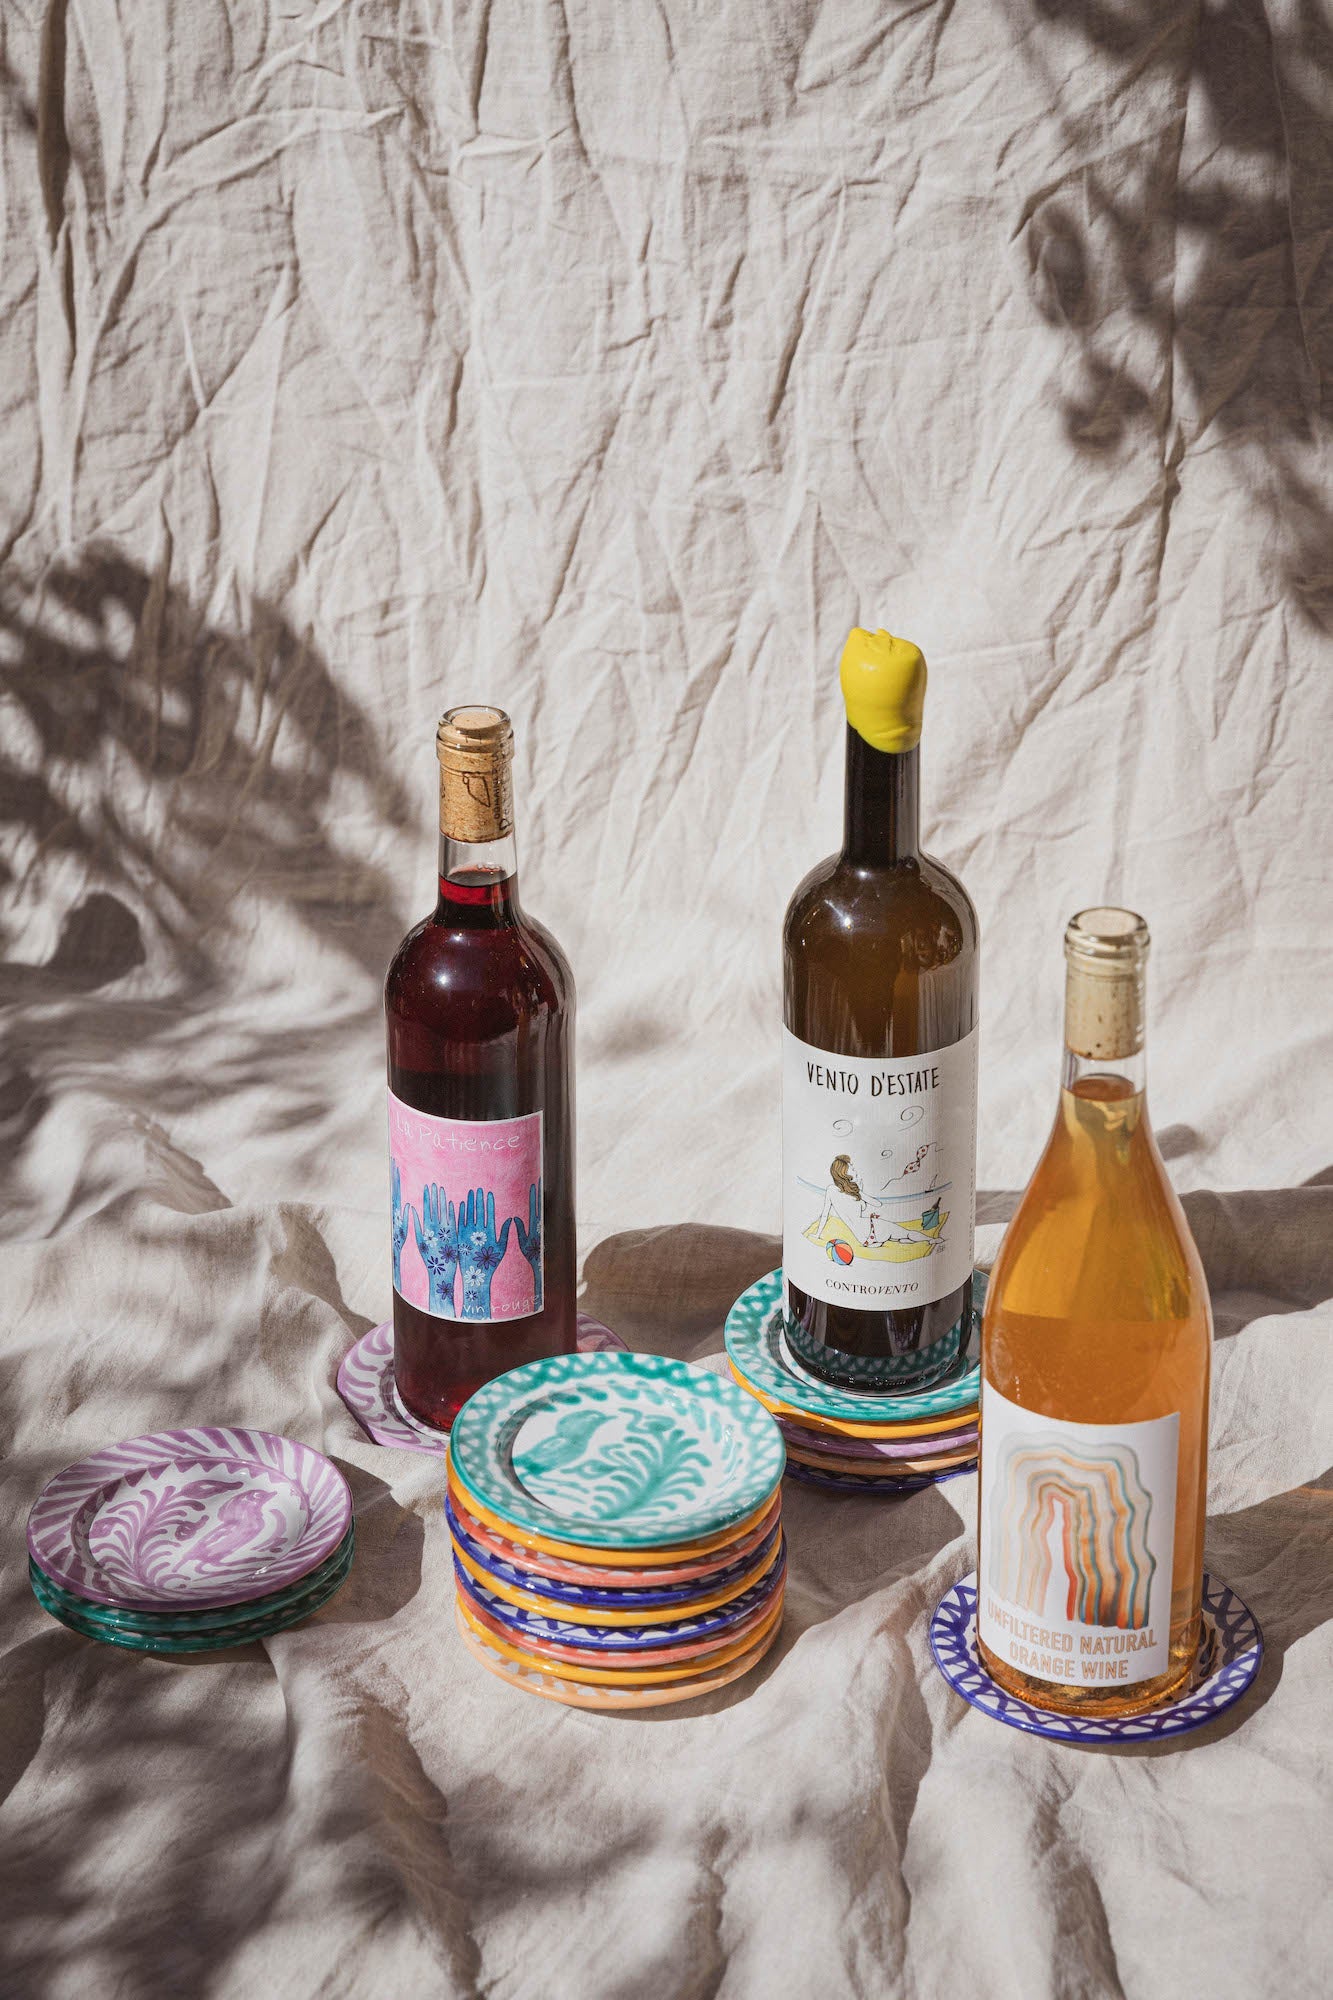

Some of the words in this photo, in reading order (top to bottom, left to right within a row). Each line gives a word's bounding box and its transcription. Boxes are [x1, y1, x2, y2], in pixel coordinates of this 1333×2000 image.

[807, 1061, 859, 1095] VENTO
[871, 1067, 940, 1096] D'ESTATE
[396, 1111, 413, 1137] La
[419, 1125, 521, 1152] Patience
[463, 1303, 485, 1314] vin
[491, 1294, 540, 1313] rouge
[825, 1278, 919, 1295] CONTROVENTO
[987, 1597, 1074, 1653] UNFILTERED
[1080, 1629, 1157, 1655] NATURAL
[1009, 1641, 1076, 1678] ORANGE
[1081, 1659, 1129, 1679] WINE
